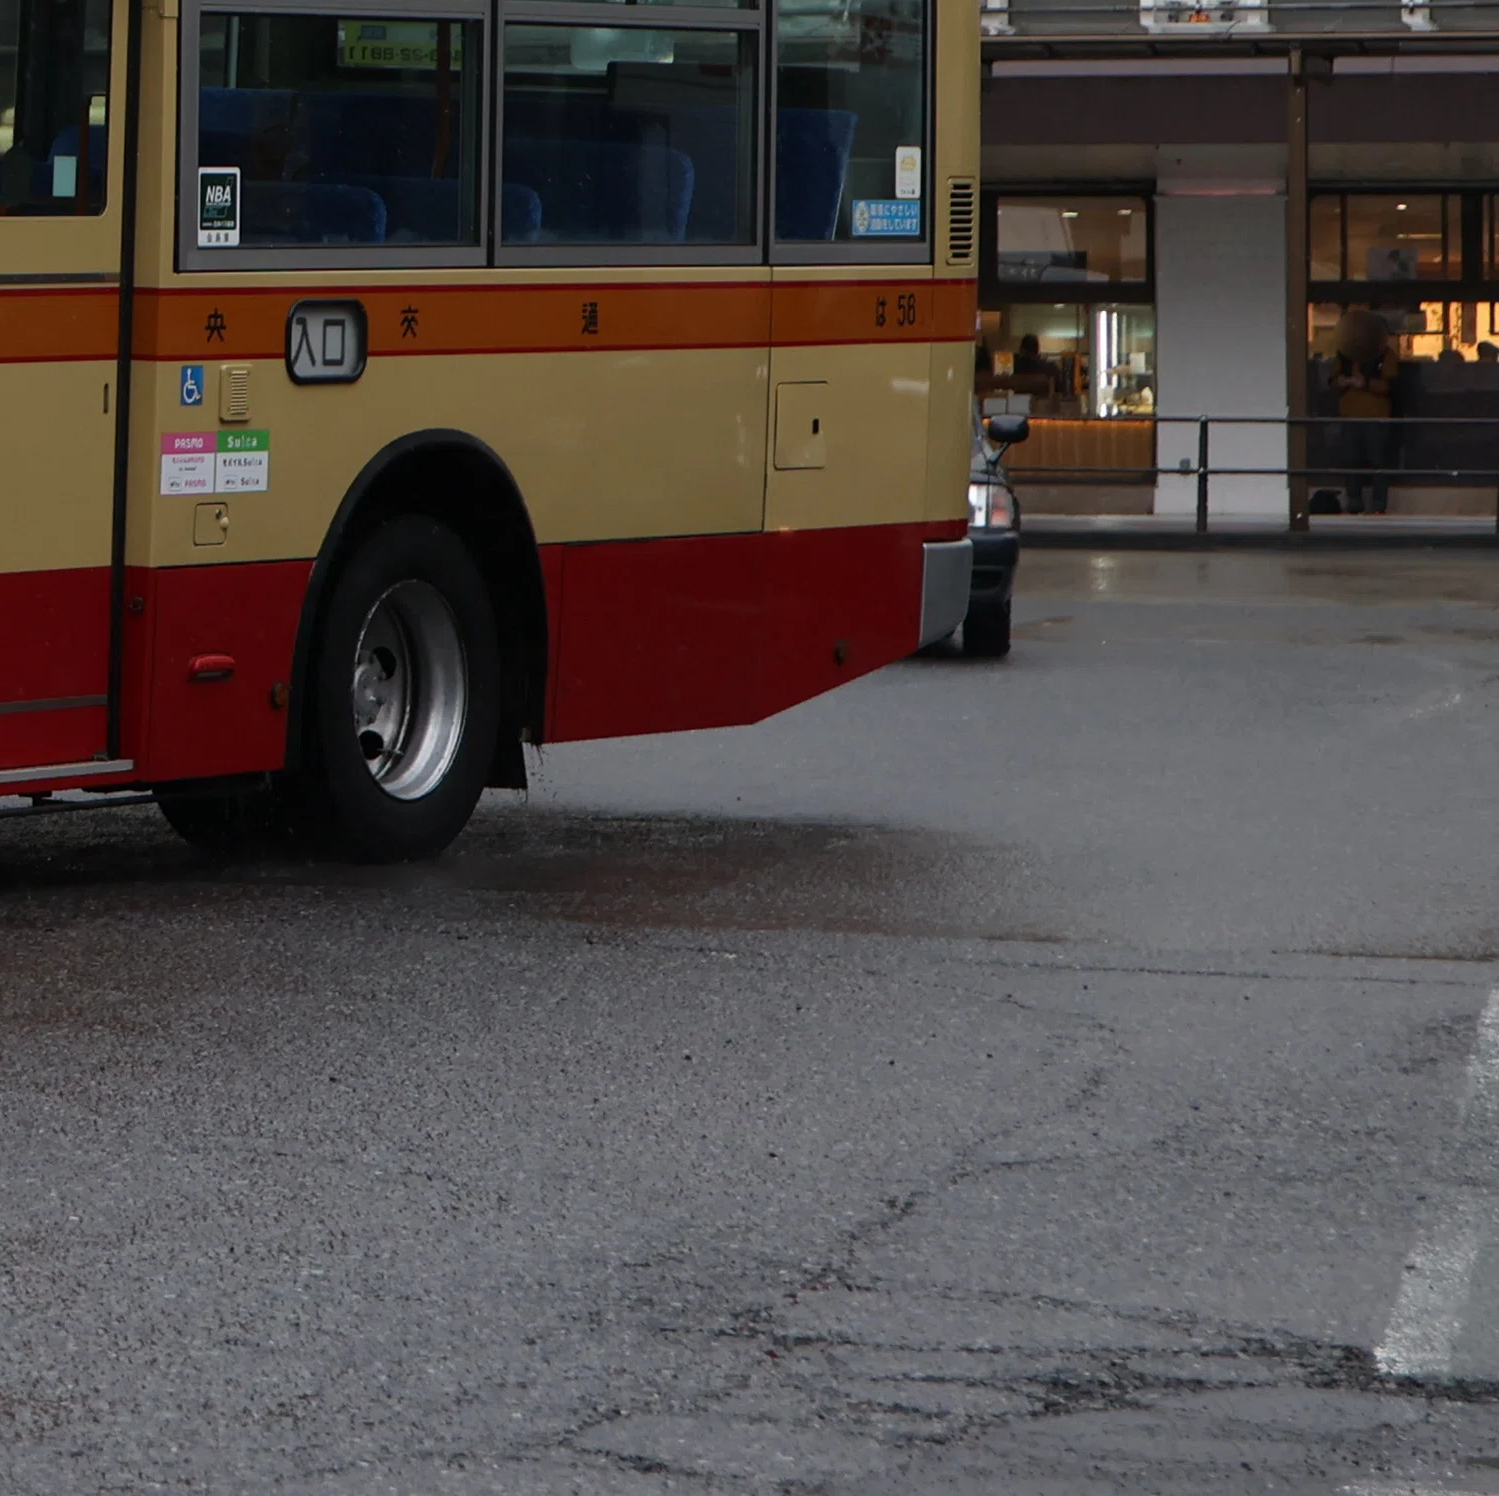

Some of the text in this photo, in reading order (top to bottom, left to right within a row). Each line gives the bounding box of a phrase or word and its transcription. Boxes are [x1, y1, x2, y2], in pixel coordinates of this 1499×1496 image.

[206, 185, 231, 204] NBA
[204, 307, 227, 343] 央
[292, 317, 345, 367] 入口
[174, 437, 204, 449] PASMO
[227, 435, 258, 449] Suica
